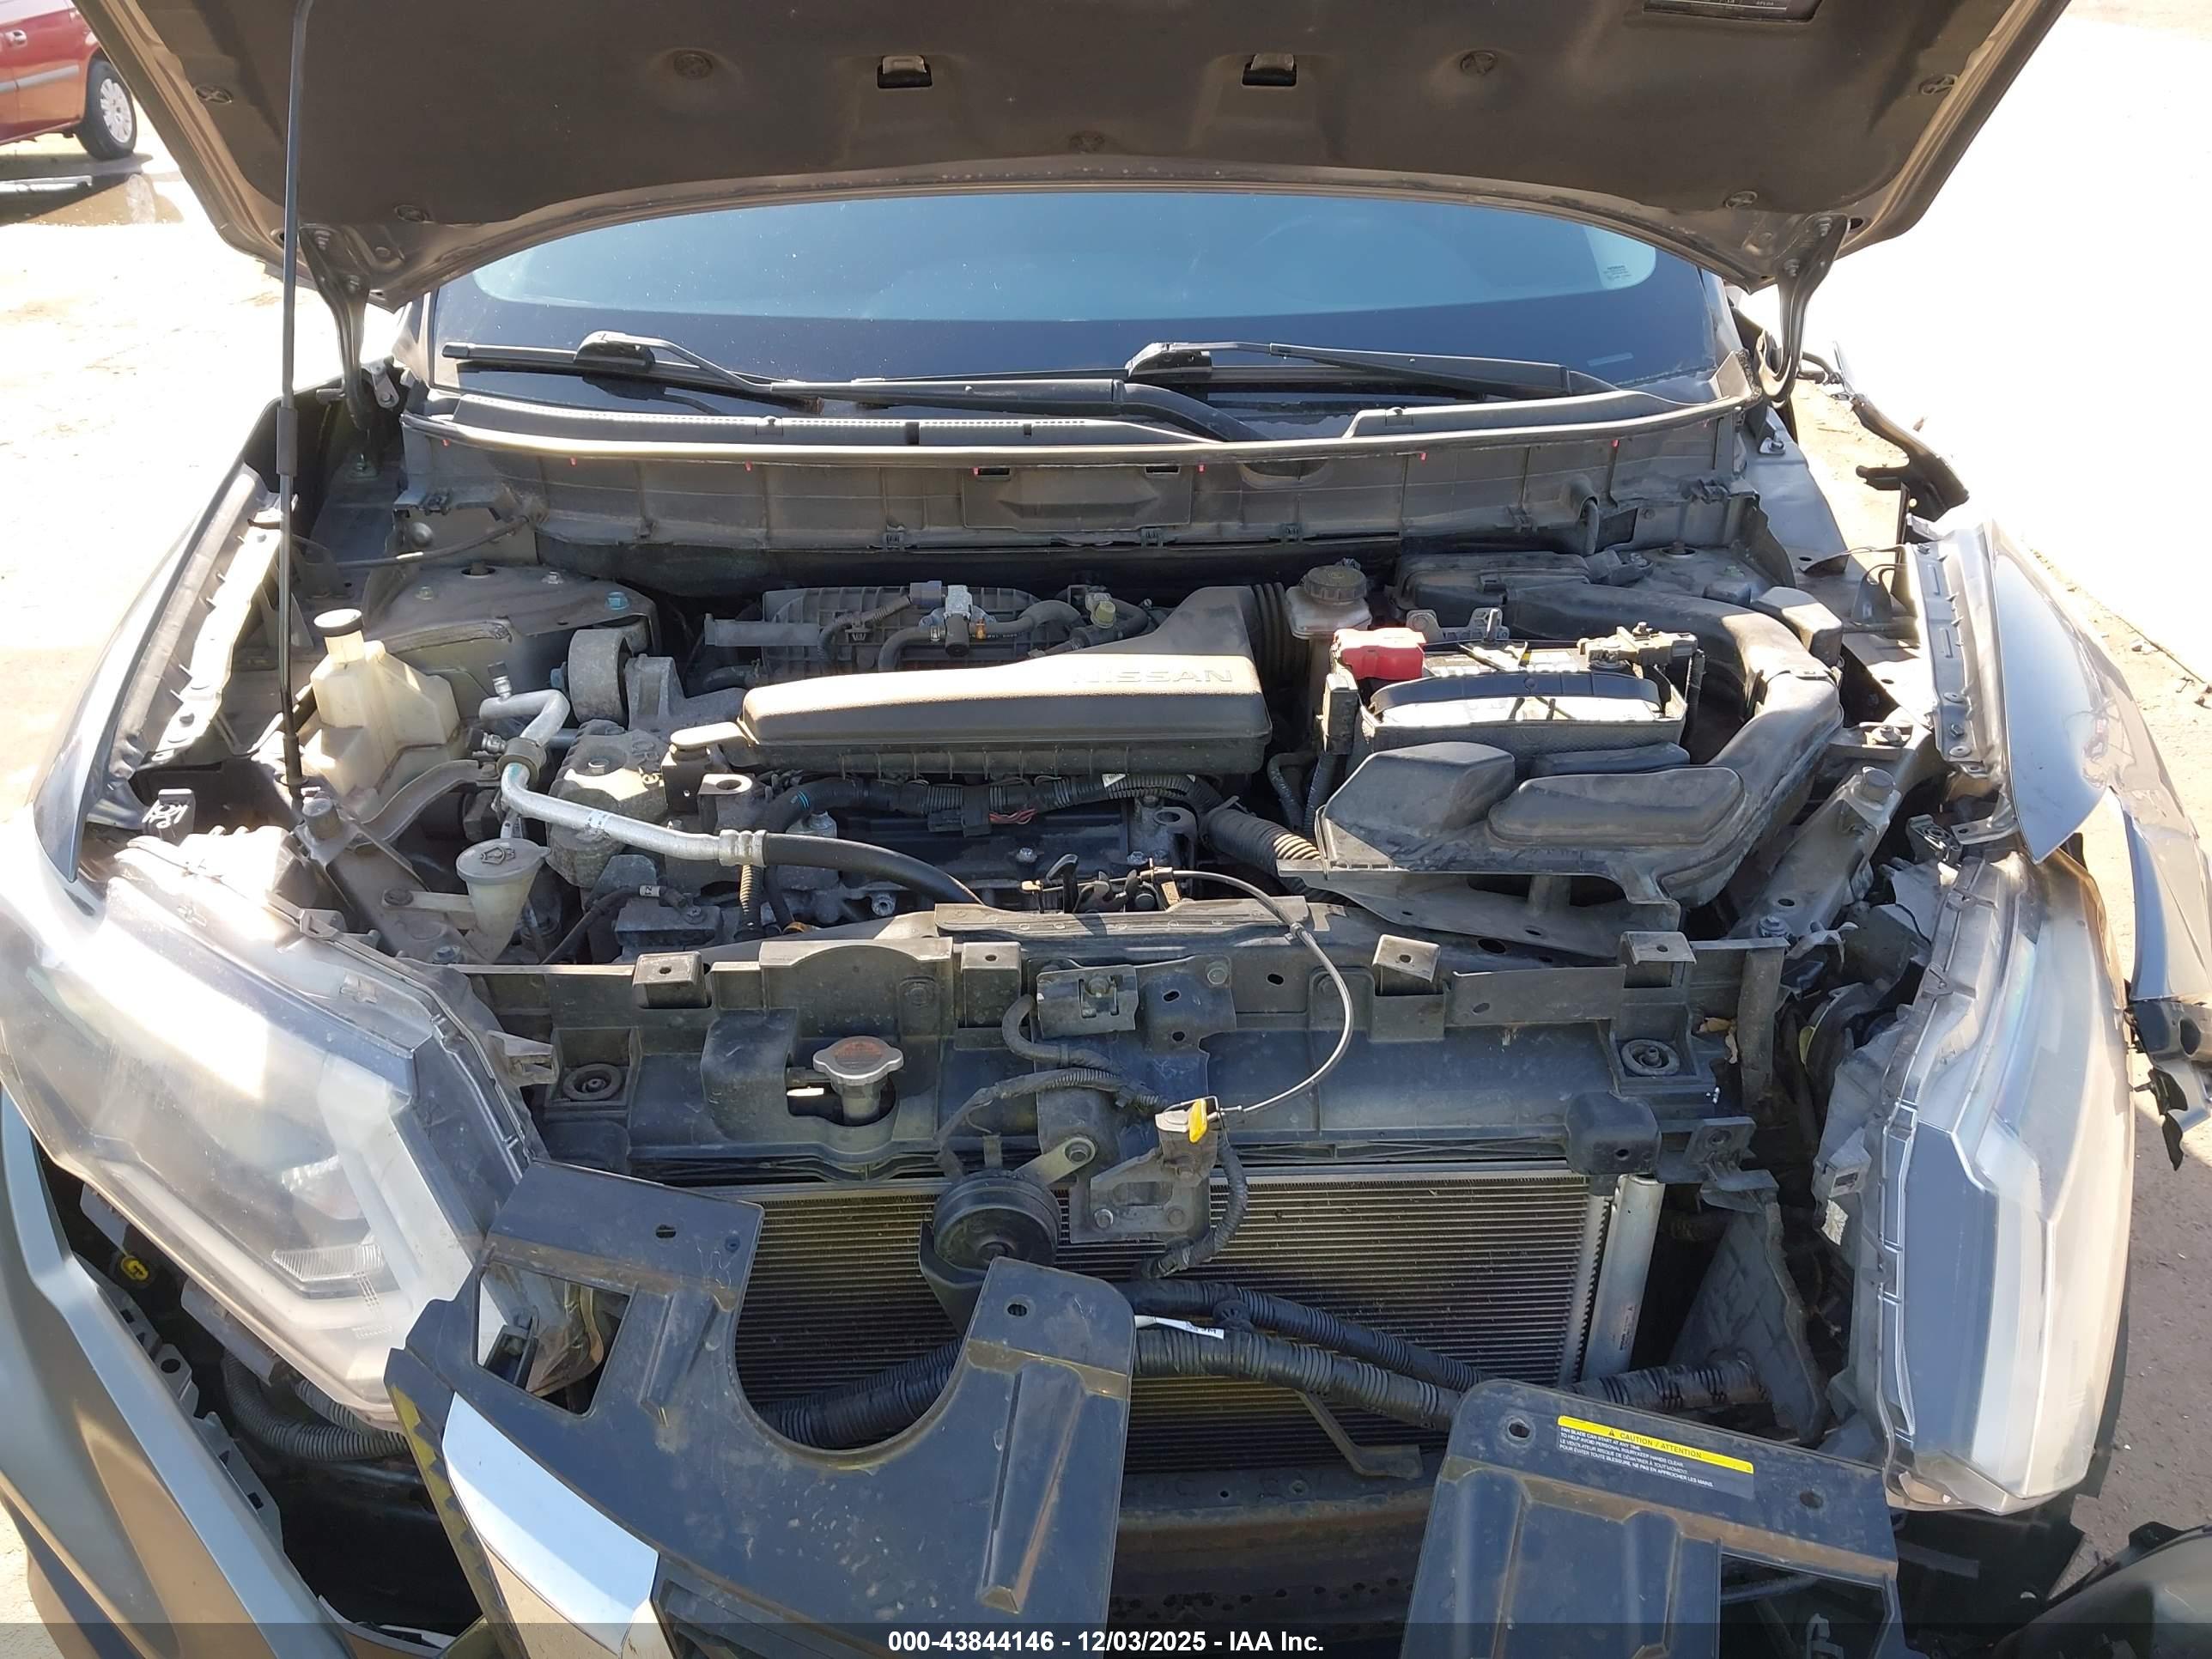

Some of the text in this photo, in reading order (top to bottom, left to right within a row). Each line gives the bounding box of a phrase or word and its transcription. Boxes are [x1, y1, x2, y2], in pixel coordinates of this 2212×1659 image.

[1073, 670, 1232, 683] NISSAN
[1620, 1432, 1652, 1445] CAUTION
[1661, 1443, 1701, 1457] ATTENTION
